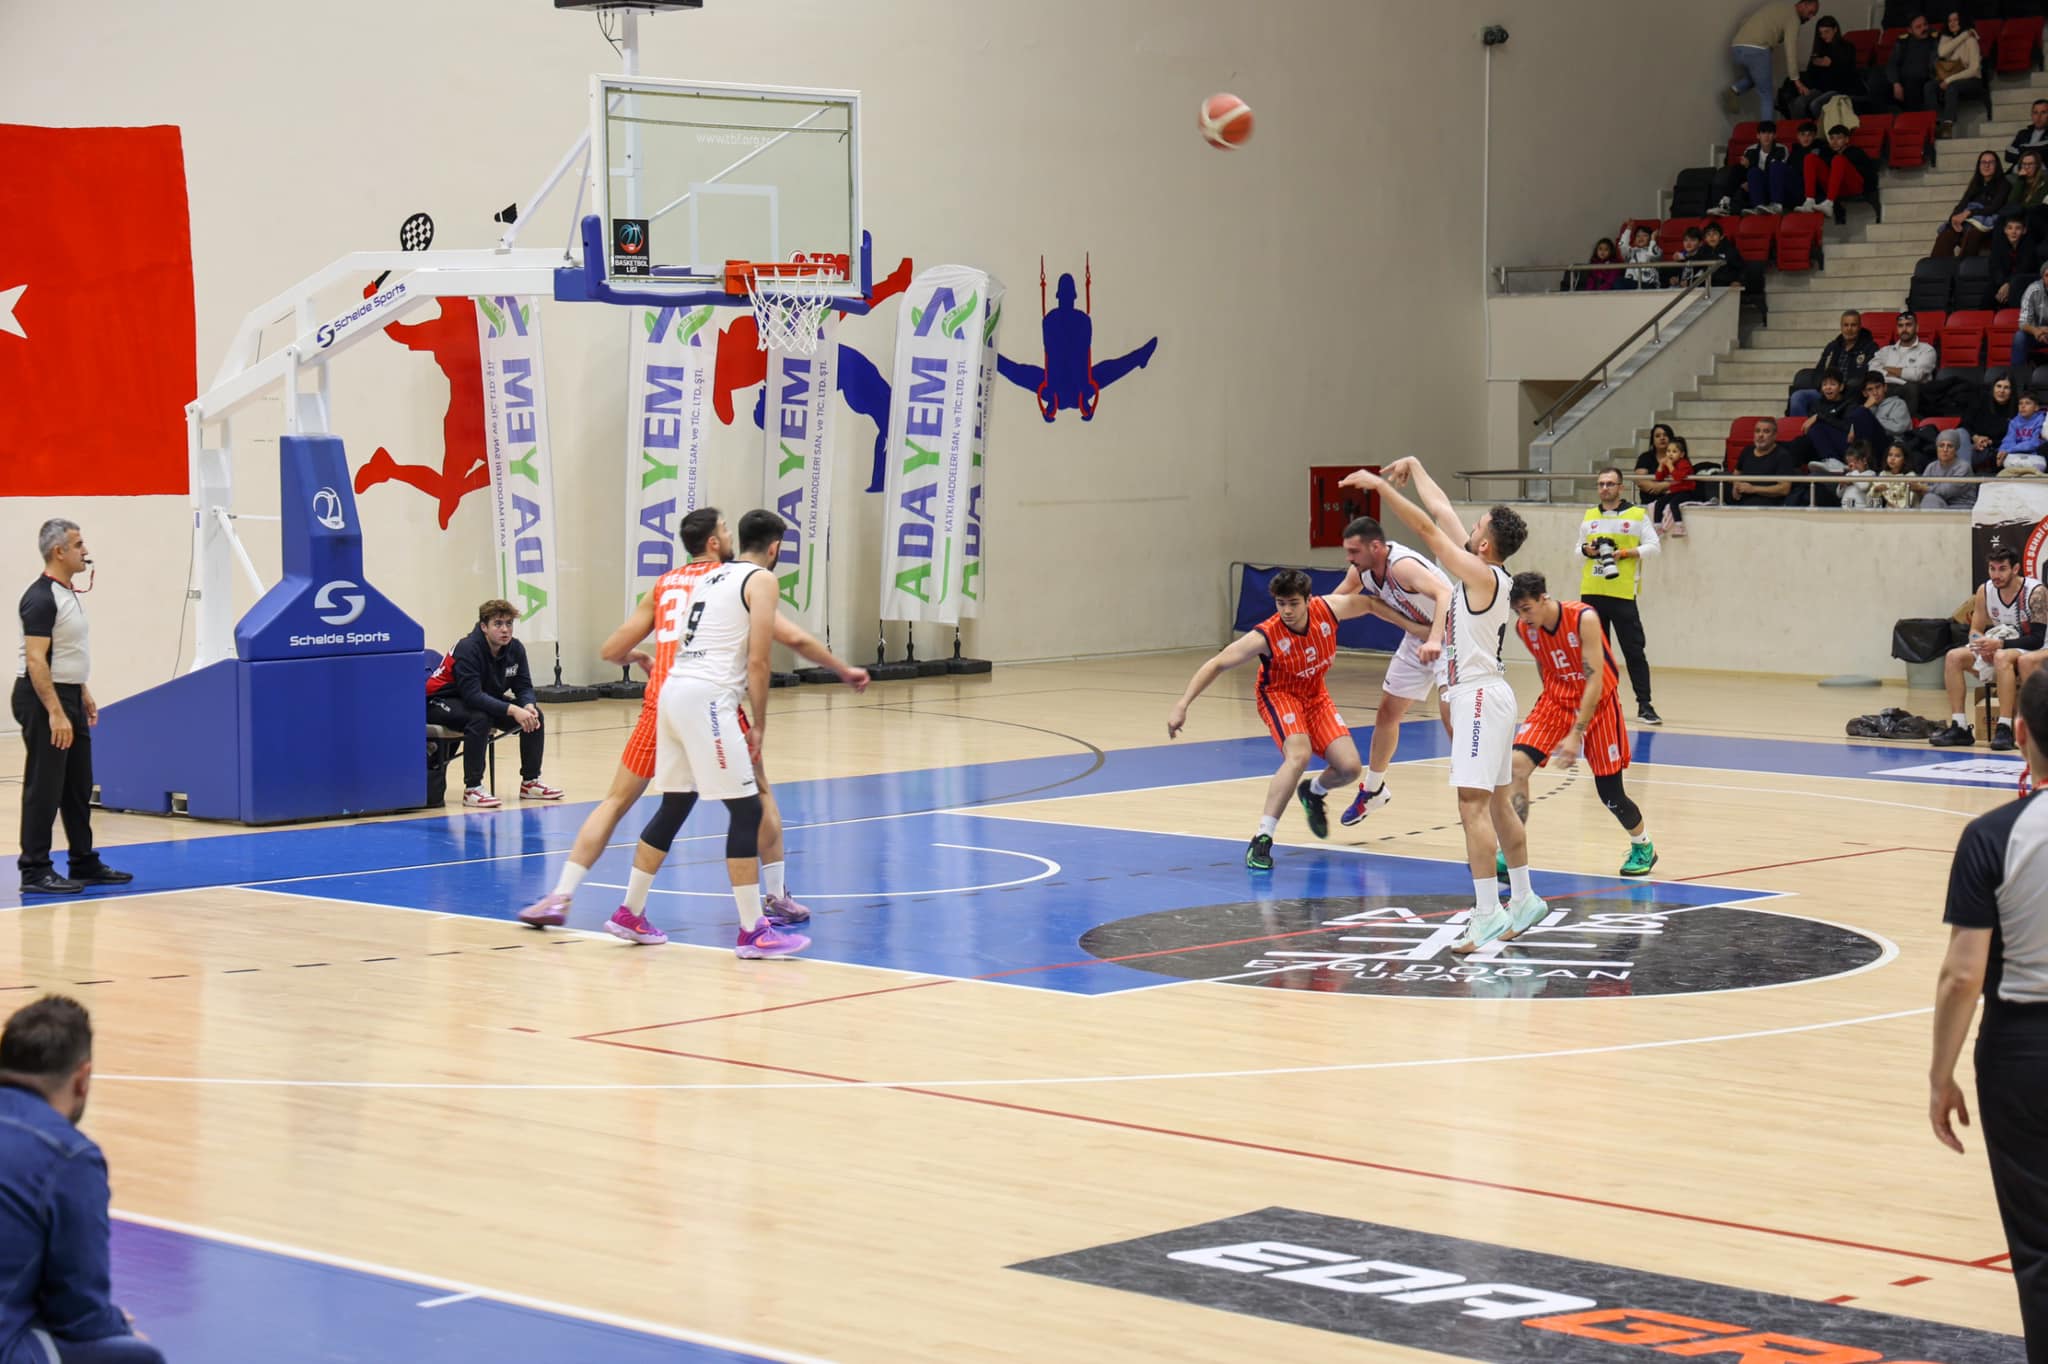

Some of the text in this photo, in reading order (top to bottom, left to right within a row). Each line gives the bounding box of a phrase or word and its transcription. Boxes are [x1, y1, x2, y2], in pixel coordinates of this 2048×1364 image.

[334, 303, 372, 331] Schelde
[373, 283, 406, 308] Sports
[808, 510, 818, 538] KATKI
[944, 505, 954, 532] KATKI
[290, 631, 390, 646] Schelde Sports
[1305, 646, 1316, 663] 2
[1550, 649, 1570, 669] 12
